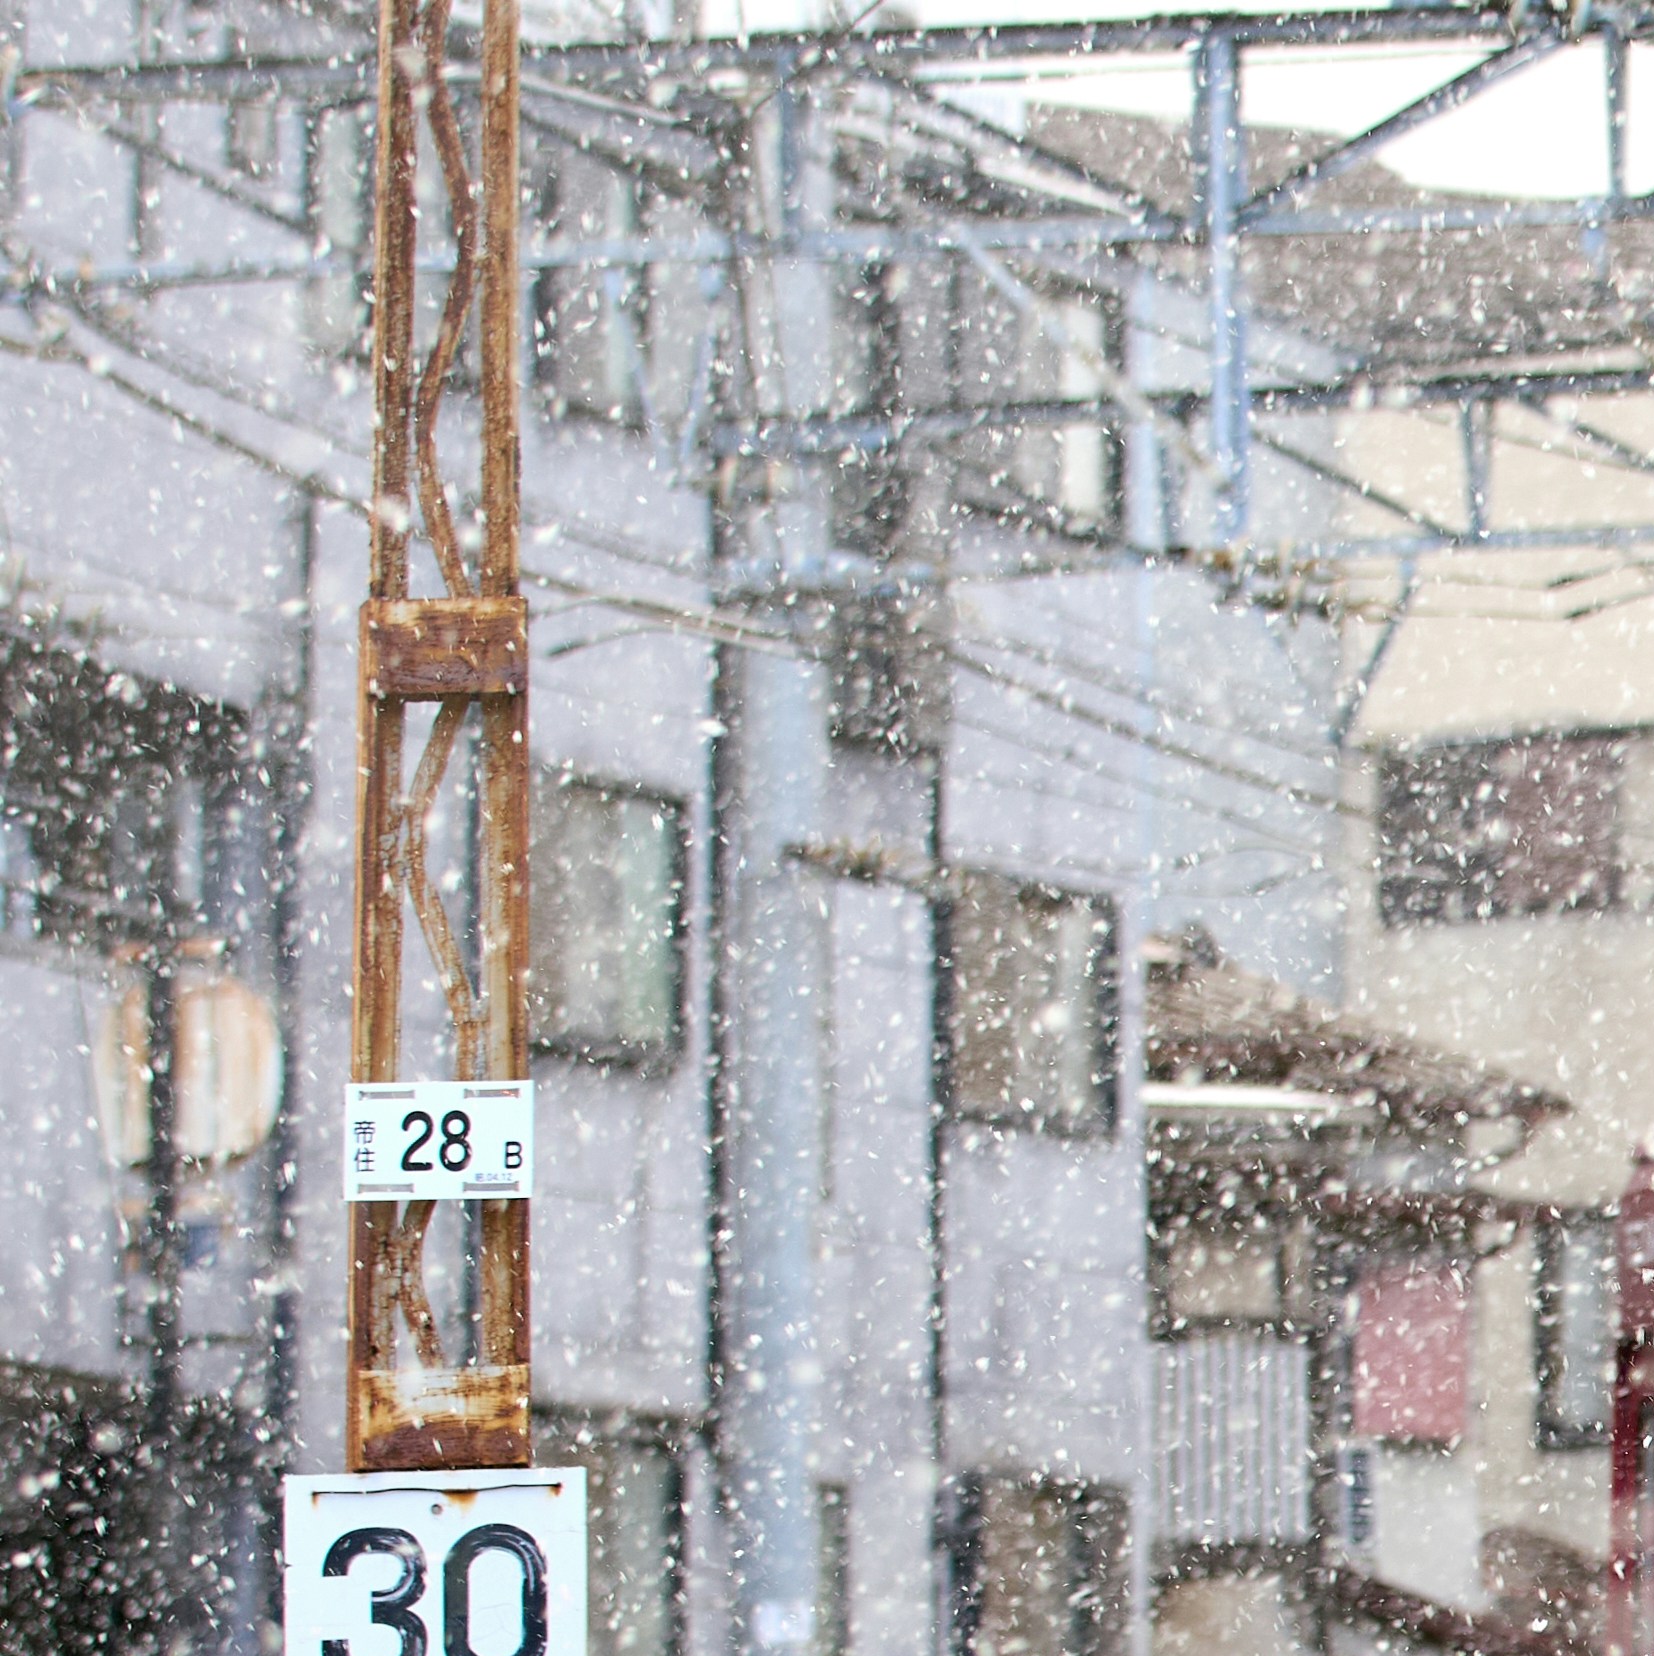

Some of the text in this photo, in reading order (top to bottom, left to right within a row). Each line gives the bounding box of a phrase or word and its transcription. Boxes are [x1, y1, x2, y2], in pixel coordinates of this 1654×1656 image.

[353, 1120, 376, 1172] 帝住
[400, 1109, 473, 1172] 28
[504, 1140, 523, 1169] B
